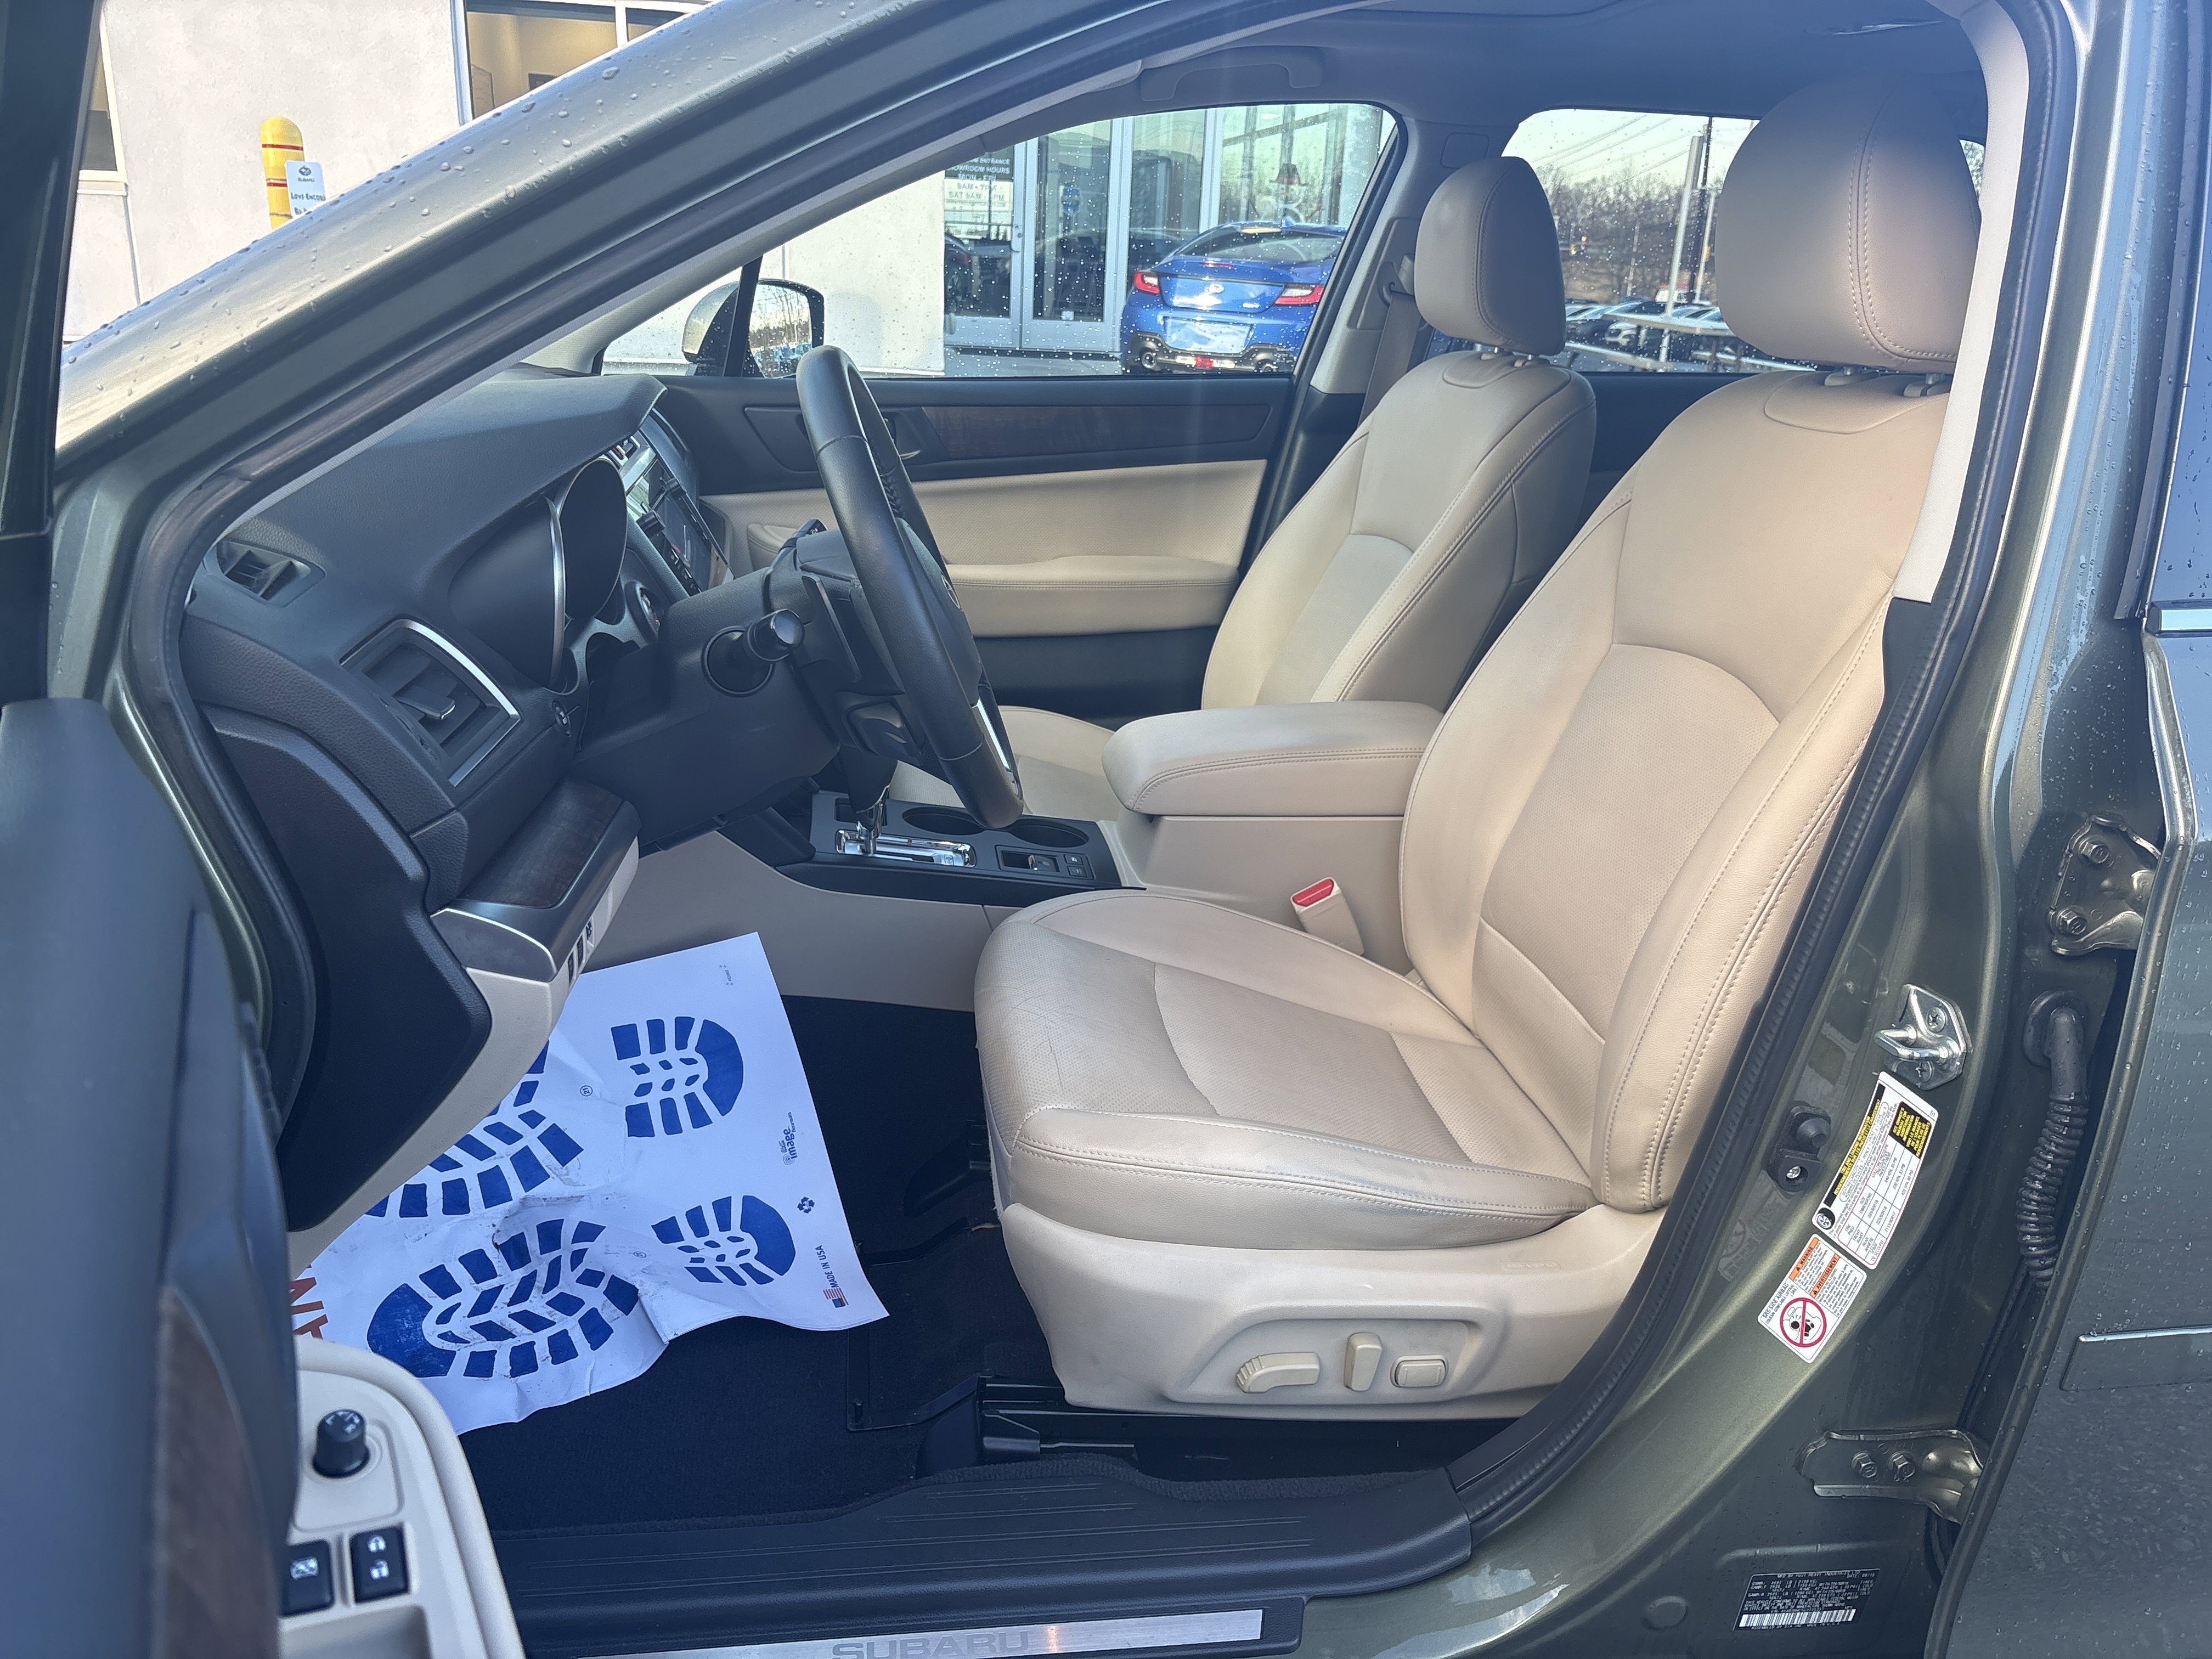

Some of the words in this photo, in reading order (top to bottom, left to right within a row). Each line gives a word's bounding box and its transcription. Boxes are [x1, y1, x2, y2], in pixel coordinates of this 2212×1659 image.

[1895, 1119, 1905, 1136] MANUAL
[1899, 1113, 1911, 1137] ADDITIONAL
[1849, 1164, 1859, 1181] CAPACITY
[1852, 1228, 1860, 1242] FRONT
[815, 1244, 827, 1260] USA
[1799, 1246, 1813, 1265] WARNING
[1874, 1239, 1883, 1257] SECOURS
[825, 1271, 839, 1288] MADE
[1816, 1256, 1838, 1289] AVERTISSEMENT
[1762, 1308, 1770, 1319] SRS
[1768, 1298, 1778, 1310] SIDE
[1775, 1282, 1788, 1300] AIRBAG
[832, 1630, 1029, 1659] SUBARU
